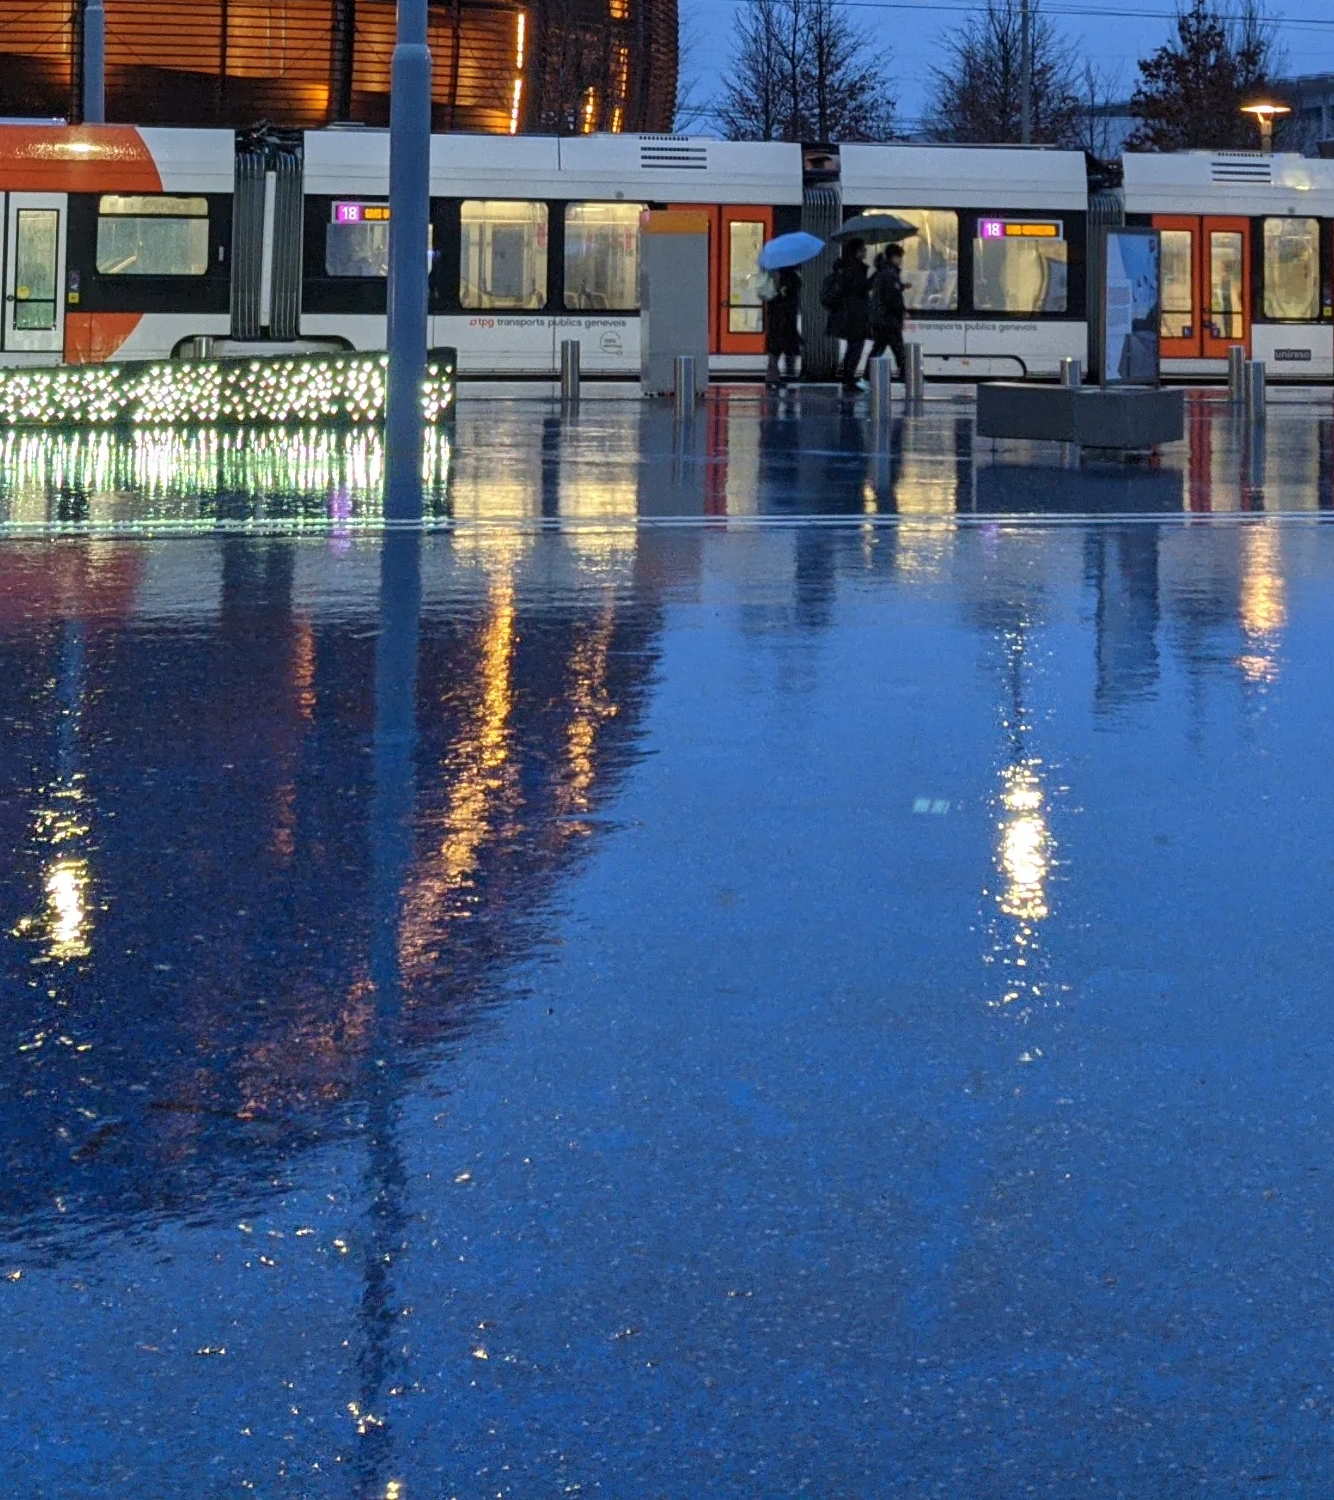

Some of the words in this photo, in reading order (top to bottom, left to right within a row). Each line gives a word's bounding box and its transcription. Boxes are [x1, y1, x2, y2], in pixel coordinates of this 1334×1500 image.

[341, 206, 358, 220] 18
[986, 223, 1001, 236] 18
[479, 318, 495, 329] tpg
[497, 318, 545, 328] transports
[548, 318, 582, 329] publics
[585, 318, 627, 329] genevois
[964, 322, 997, 333] publics
[999, 323, 1038, 333] genevois
